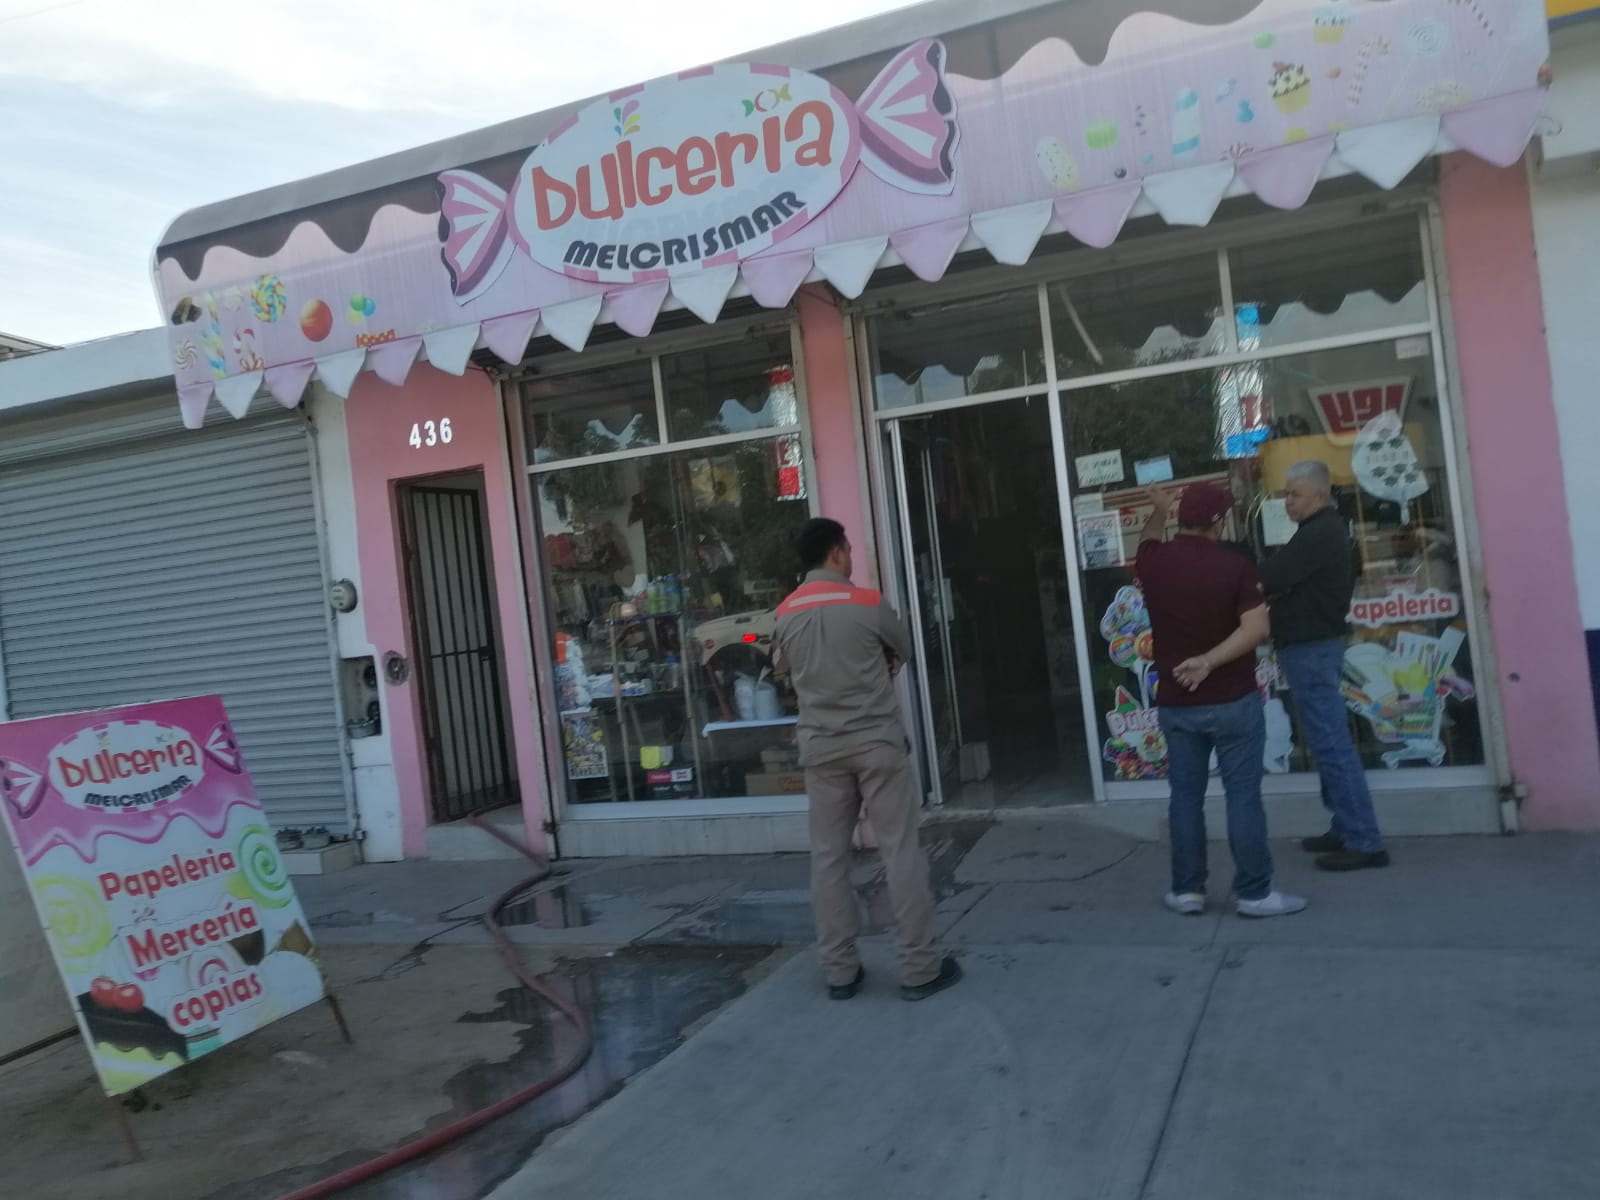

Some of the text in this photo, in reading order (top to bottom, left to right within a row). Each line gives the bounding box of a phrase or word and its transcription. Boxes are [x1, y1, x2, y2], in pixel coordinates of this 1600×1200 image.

[563, 191, 807, 270] MELCRISMAR
[408, 417, 454, 449] 436
[1350, 592, 1454, 624] apeleria
[98, 848, 236, 901] Papeleria
[126, 902, 257, 967] Mercería
